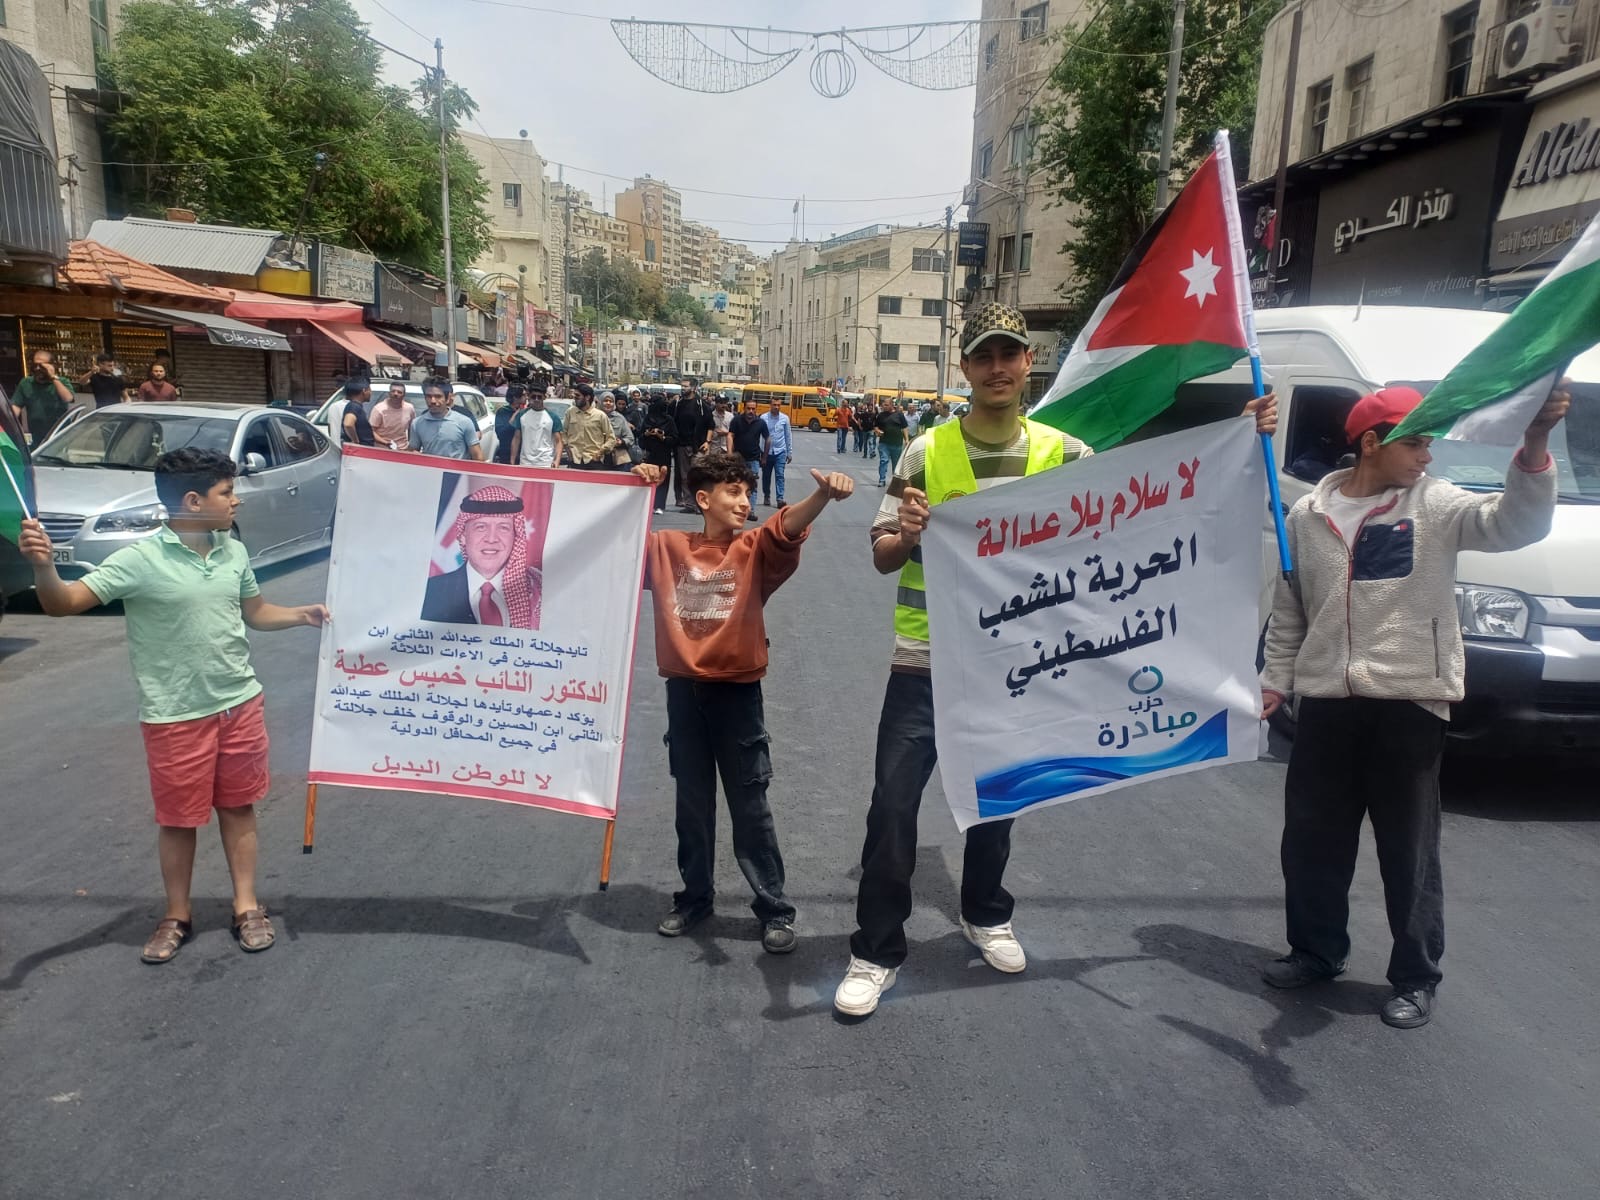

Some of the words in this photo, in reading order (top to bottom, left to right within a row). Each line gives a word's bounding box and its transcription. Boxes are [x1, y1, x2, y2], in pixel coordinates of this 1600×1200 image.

[1177, 456, 1200, 500] لا
[1110, 472, 1170, 532] سلام
[1067, 490, 1104, 540] بلا
[976, 511, 1061, 557] عدالة
[1084, 531, 1198, 603] الحرية
[979, 567, 1077, 639] للشعب
[368, 626, 389, 638] ابن
[393, 628, 434, 643] الثاني
[390, 641, 434, 656] الثلاثة
[489, 636, 524, 649] الملك
[1006, 603, 1178, 698] الفلسطيني
[334, 649, 390, 681] عطية
[488, 651, 509, 667] في
[512, 656, 563, 670] الحسين
[399, 664, 467, 689] خميس
[475, 669, 533, 695] النائب
[426, 691, 468, 709] لجلالة
[541, 679, 608, 705] الدكتور
[382, 706, 417, 719] خلف
[1128, 695, 1164, 713] حزب
[390, 720, 438, 737] الدولية
[488, 717, 538, 733] الحسين
[542, 725, 564, 738] ابن
[1097, 710, 1198, 749] مبادرة
[442, 726, 493, 743] المحافل
[498, 736, 534, 750] جميع
[568, 728, 604, 743] الثاني
[537, 738, 557, 755] في
[372, 755, 441, 775] البديل
[452, 763, 526, 786] للوطن
[535, 773, 552, 790] لا
